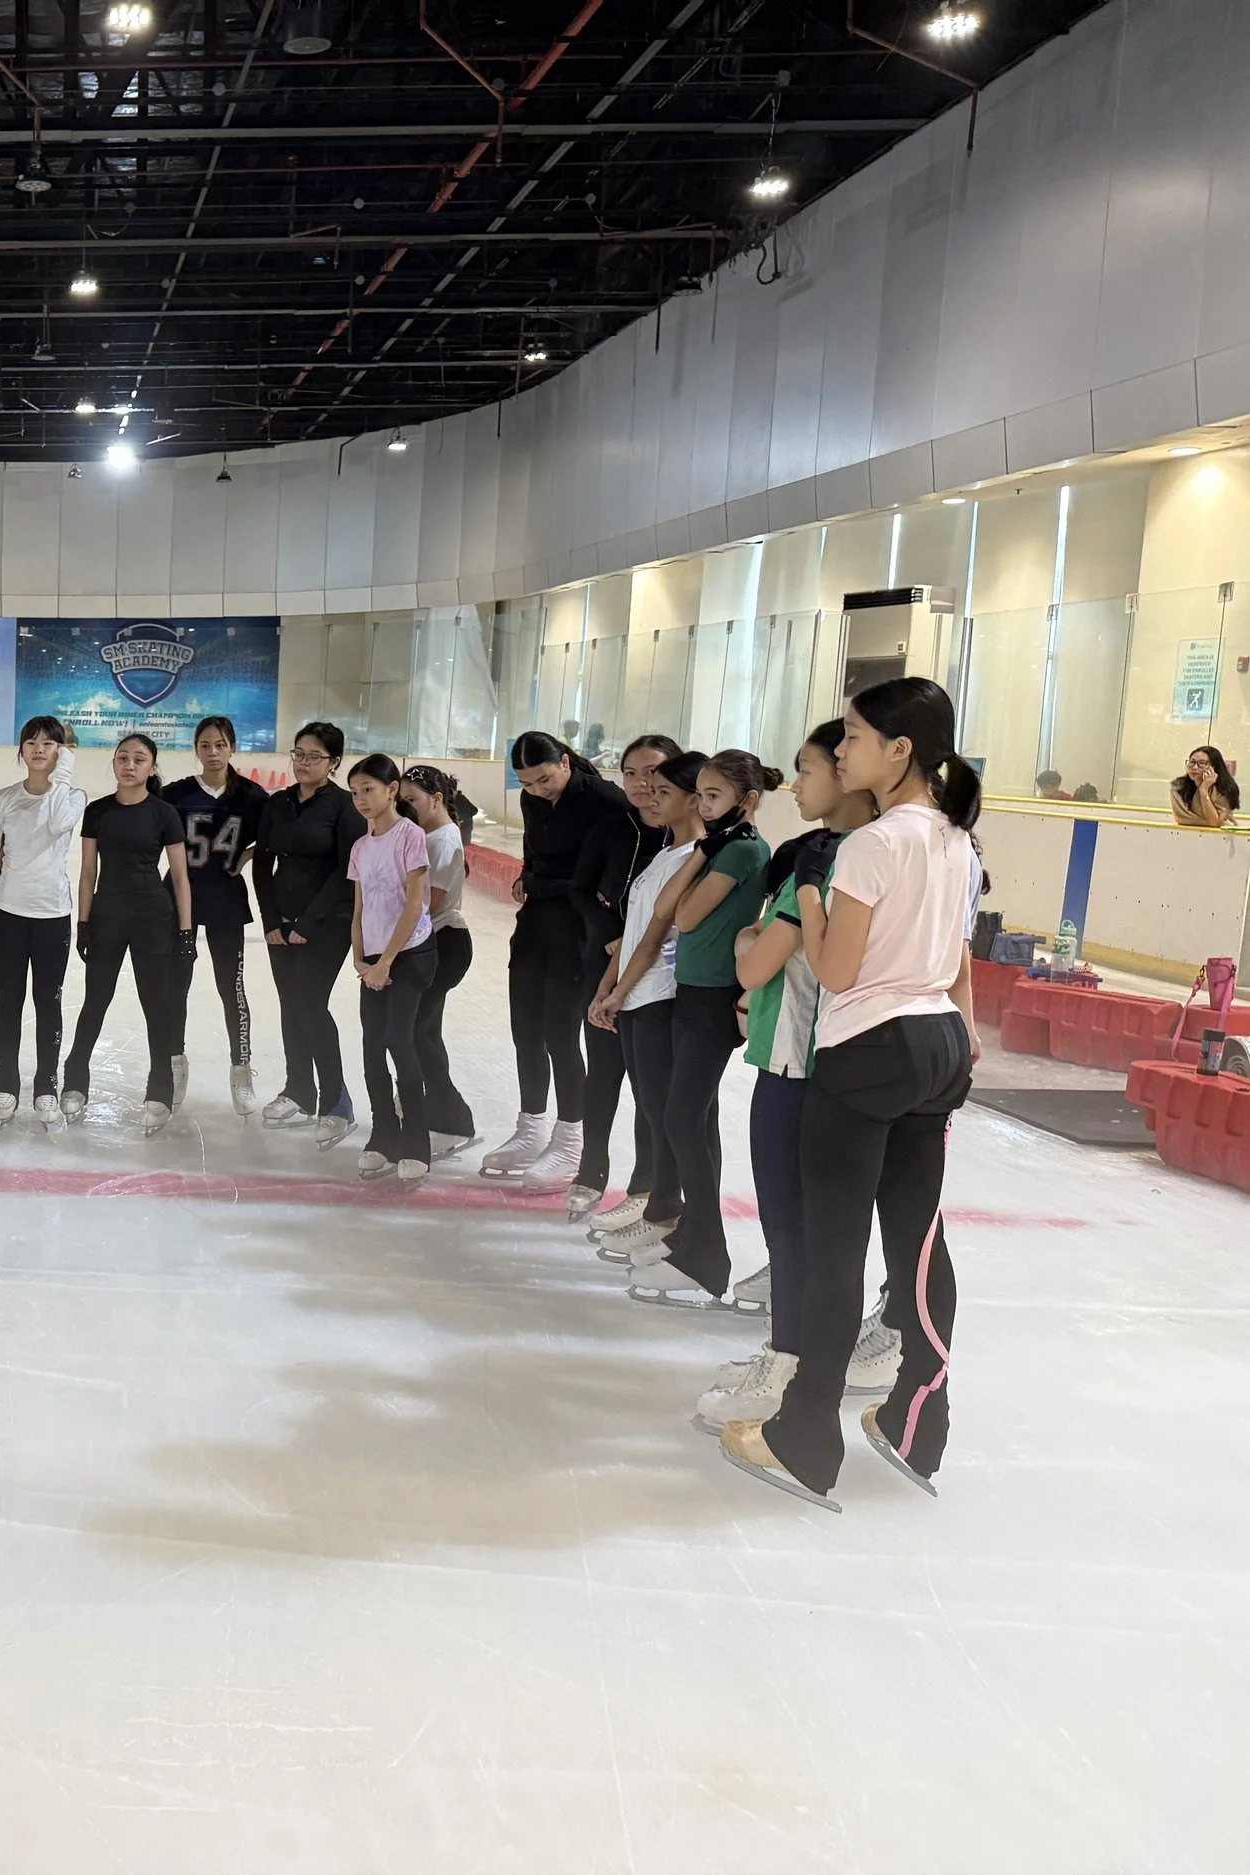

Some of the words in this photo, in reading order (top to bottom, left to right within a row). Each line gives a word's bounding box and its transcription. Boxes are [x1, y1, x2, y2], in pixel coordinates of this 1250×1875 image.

[103, 643, 125, 660] SM
[127, 641, 192, 661] SKATING
[114, 655, 181, 672] ACADEMY
[53, 709, 92, 717] UNLEASH
[94, 710, 117, 718] YOUR
[63, 719, 100, 727] ENROLL
[100, 719, 129, 728] NOW!
[151, 730, 170, 738] CITY
[186, 814, 242, 872] 54
[235, 961, 246, 1009] UNDER
